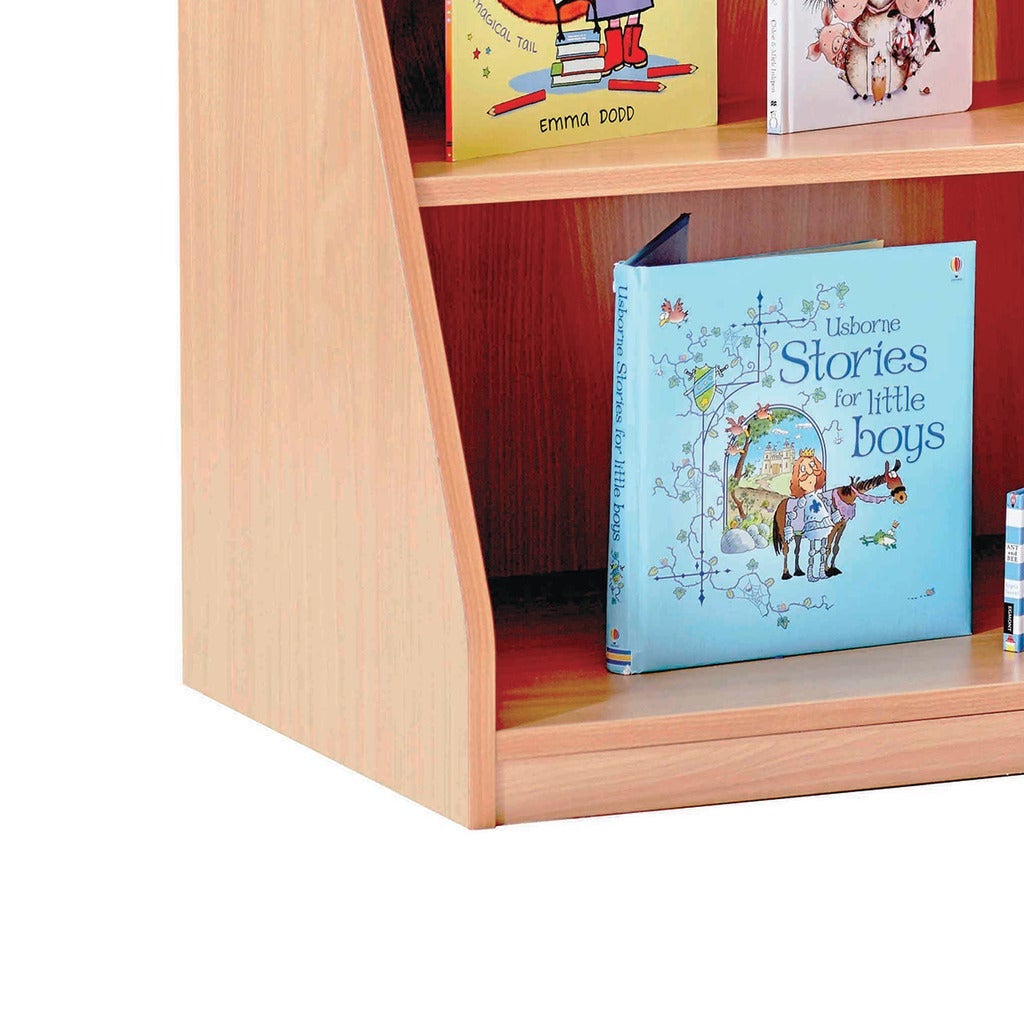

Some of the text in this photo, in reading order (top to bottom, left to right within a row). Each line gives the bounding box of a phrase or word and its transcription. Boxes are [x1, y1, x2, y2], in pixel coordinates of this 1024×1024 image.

[599, 105, 635, 124] DODD
[826, 315, 901, 337] Usborne
[779, 339, 928, 384] Stories
[612, 286, 627, 541] Usborne Stories for little boys
[834, 385, 925, 415] for little
[851, 415, 945, 463] boys
